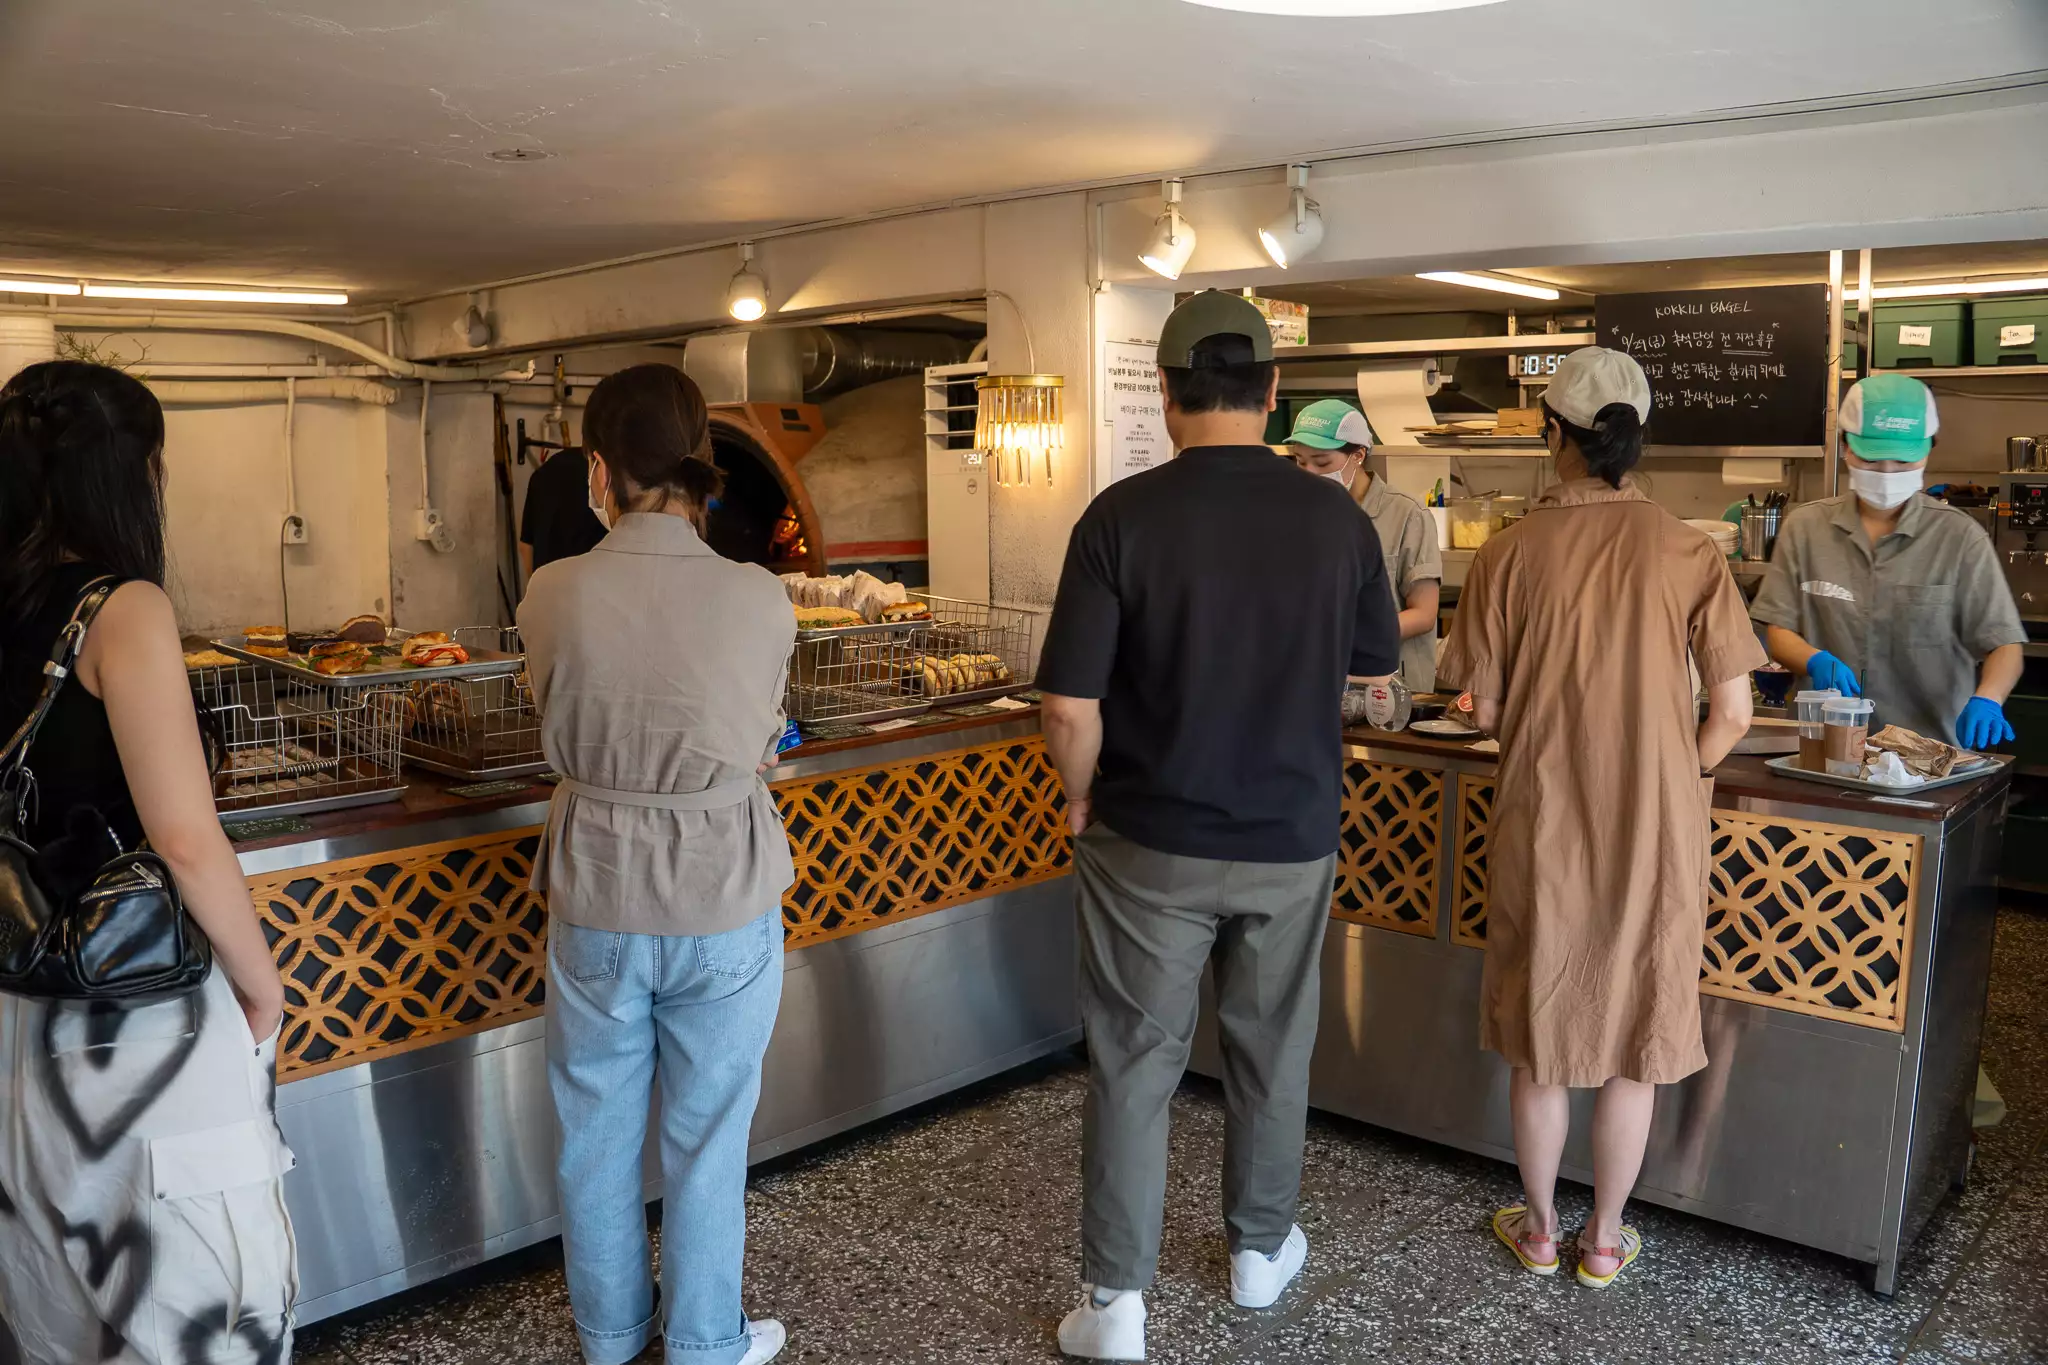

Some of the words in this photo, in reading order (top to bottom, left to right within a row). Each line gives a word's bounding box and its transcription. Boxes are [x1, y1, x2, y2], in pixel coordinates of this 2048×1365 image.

[1655, 303, 1703, 318] KOKKILI
[1710, 300, 1753, 314] BAGEL
[1653, 390, 1674, 408] 항상
[1681, 389, 1737, 409] 감사합니다
[1120, 404, 1137, 415] 베이글
